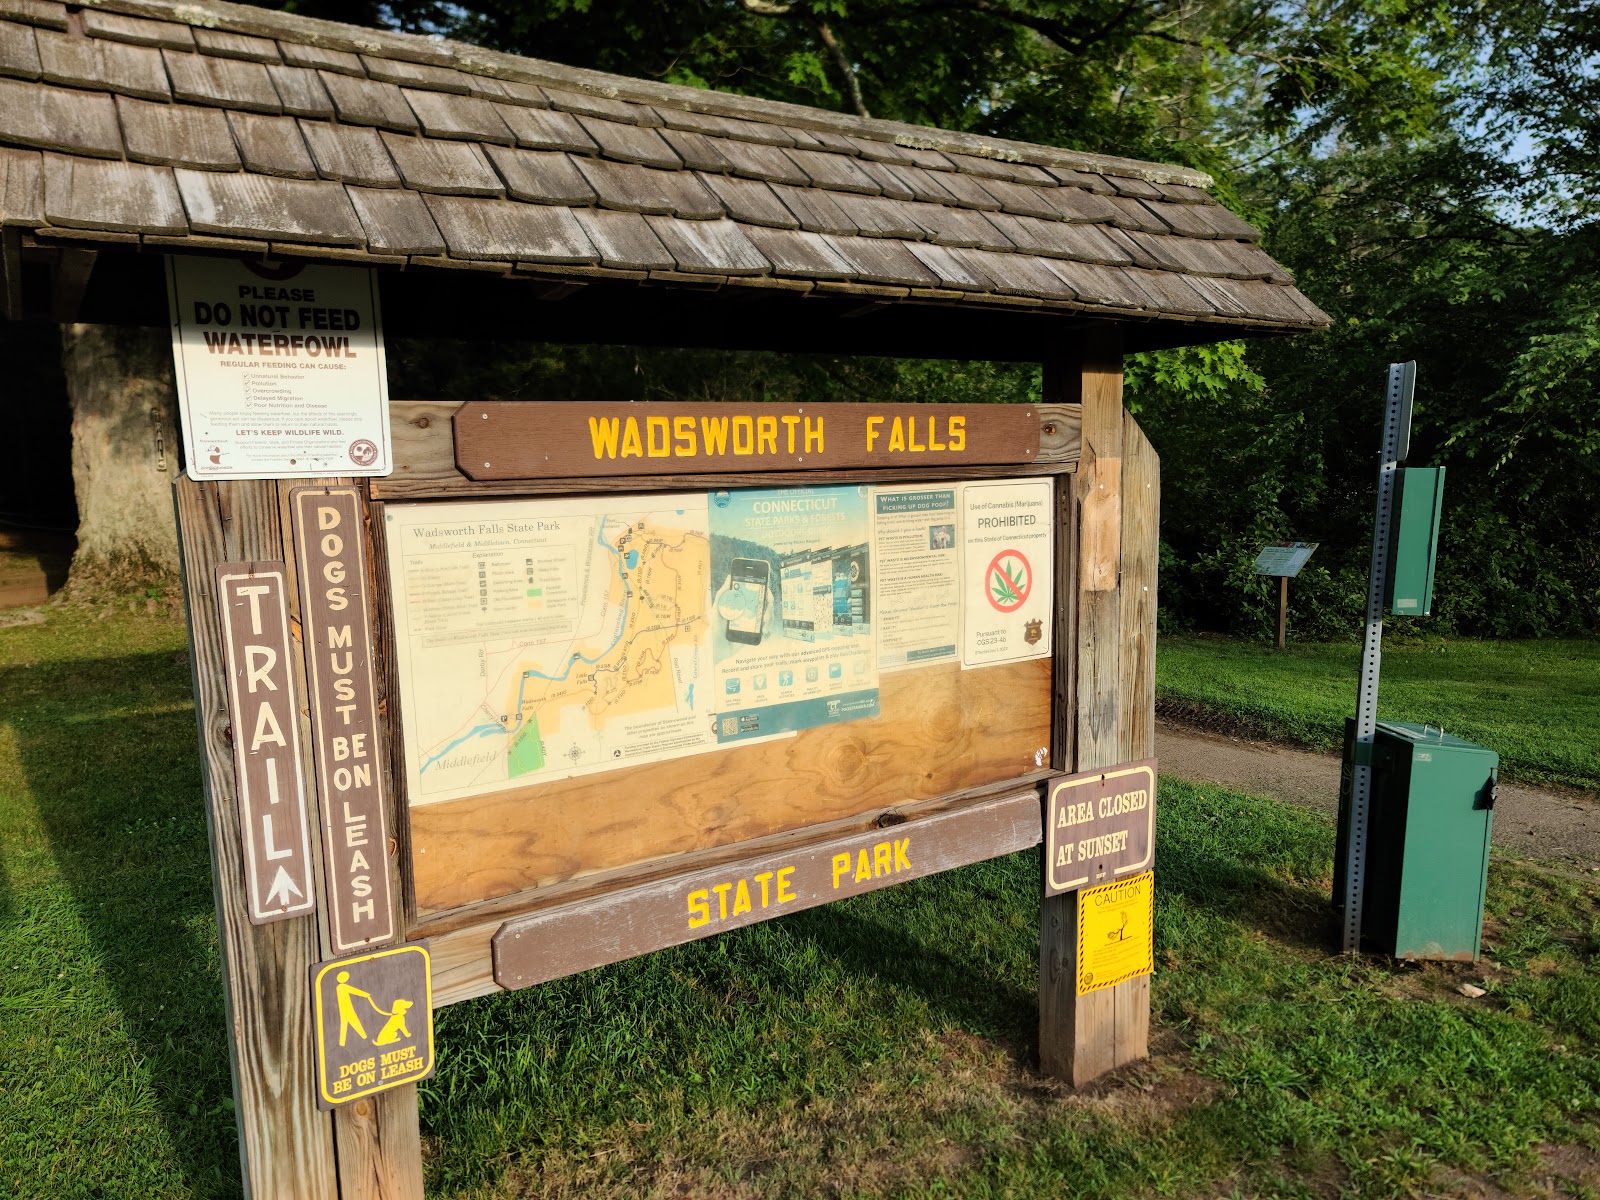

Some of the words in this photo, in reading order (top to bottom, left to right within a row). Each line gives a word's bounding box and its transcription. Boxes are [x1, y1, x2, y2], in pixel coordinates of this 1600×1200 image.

[238, 285, 315, 302] PLEASE
[194, 301, 231, 326] DO
[240, 304, 290, 328] NOT
[298, 307, 361, 331] FEED
[203, 331, 357, 358] WATERFOWL
[220, 360, 260, 369] REGULAR
[262, 361, 297, 370] FEEDING
[299, 362, 316, 370] CAN
[318, 362, 347, 371] CAUSE:
[588, 415, 825, 460] WADSWORTH
[865, 415, 967, 454] FALLS
[753, 497, 838, 514] CONNECTICUT
[970, 503, 980, 511] Use
[988, 501, 1014, 510] Cannabis
[413, 525, 475, 538] Wadsworth
[478, 524, 504, 535] Falls
[507, 523, 534, 534] State
[536, 520, 561, 531] Park
[744, 517, 772, 528] STATE
[773, 515, 800, 526] PARKS
[977, 514, 1036, 529] PROHIBITED
[317, 506, 349, 611] DOGS
[472, 551, 504, 559] Explanation
[976, 630, 1000, 638] Pursuant
[735, 656, 756, 665] Navigate
[800, 648, 822, 656] advanced
[327, 624, 358, 725] MUST
[236, 585, 292, 860] TRAIL
[332, 733, 368, 762] BE
[436, 750, 497, 771] Middlefield
[333, 763, 371, 792] ON
[1057, 800, 1094, 829] AREA
[1098, 789, 1148, 819] CLOSED
[343, 801, 375, 924] LEASH
[1056, 843, 1075, 868] AT
[1077, 829, 1129, 862] SUNSET
[687, 864, 797, 929] STATE
[832, 837, 911, 889] PARK
[1094, 884, 1141, 907] CAUTION
[332, 1077, 353, 1095] BE
[356, 1071, 376, 1088] ON
[380, 1056, 424, 1081] LEASH
[340, 1056, 376, 1080] DOGS
[379, 1045, 416, 1067] MUST
